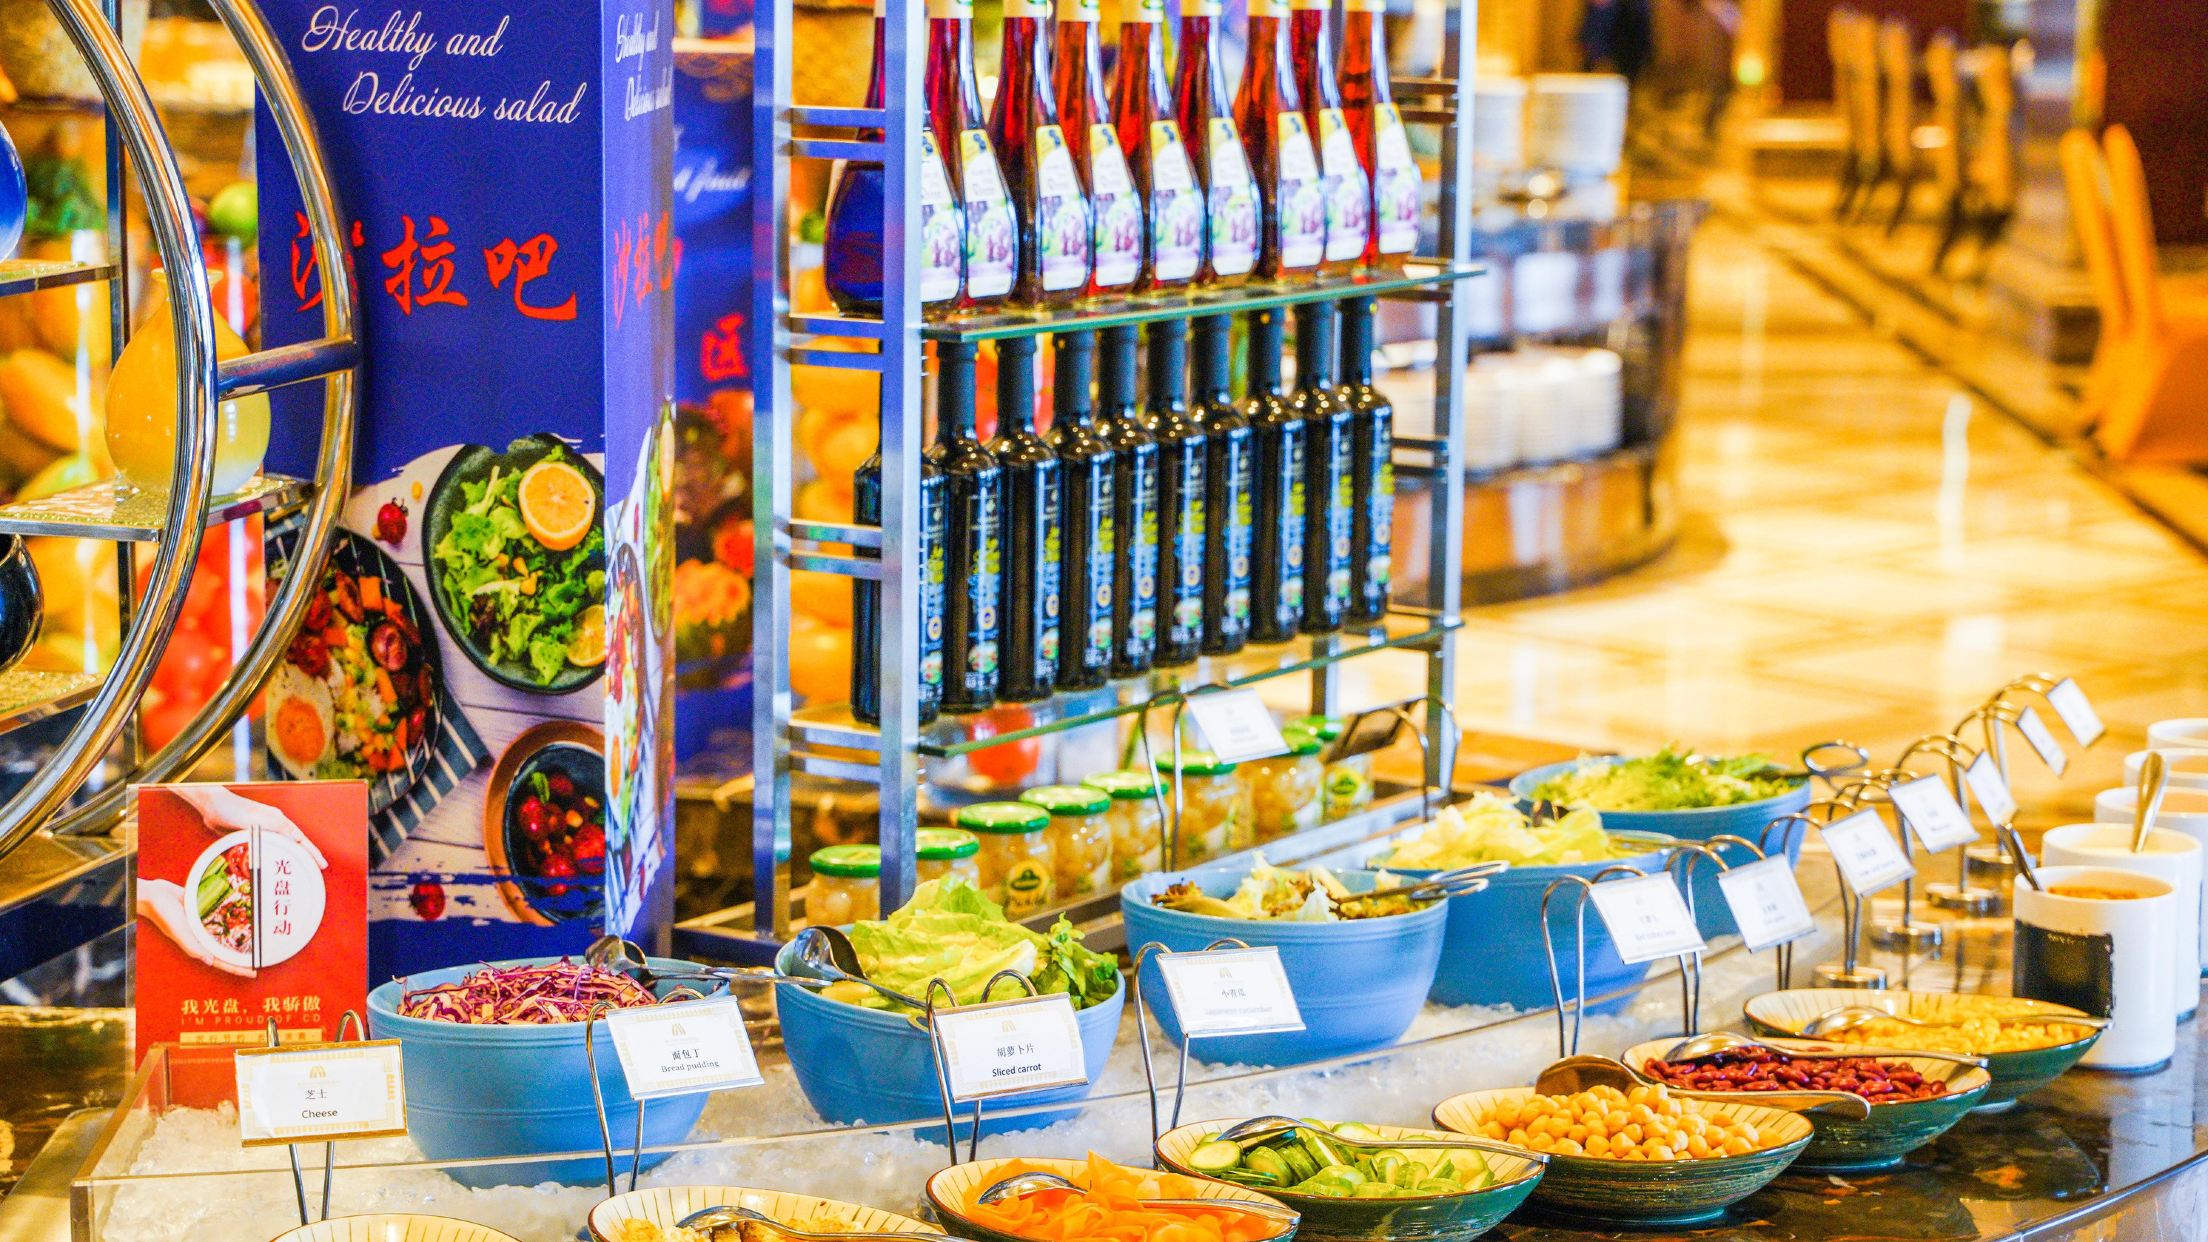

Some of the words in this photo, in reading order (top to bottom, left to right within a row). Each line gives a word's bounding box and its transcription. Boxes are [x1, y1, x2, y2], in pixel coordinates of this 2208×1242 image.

[301, 5, 437, 71] Healthy
[445, 15, 510, 57] and
[342, 71, 485, 119] Delicious
[493, 80, 587, 124] salad
[273, 859, 292, 936] 光盘行动
[215, 1014, 265, 1025] PROUD
[276, 1014, 292, 1022] OF
[303, 1012, 320, 1023] CD
[661, 1063, 685, 1073] Bread
[687, 1060, 720, 1072] pudding
[992, 1066, 1016, 1077] Sliced
[1018, 1063, 1042, 1074] carrot
[305, 1088, 328, 1100] 芝士
[302, 1109, 338, 1119] Cheese
